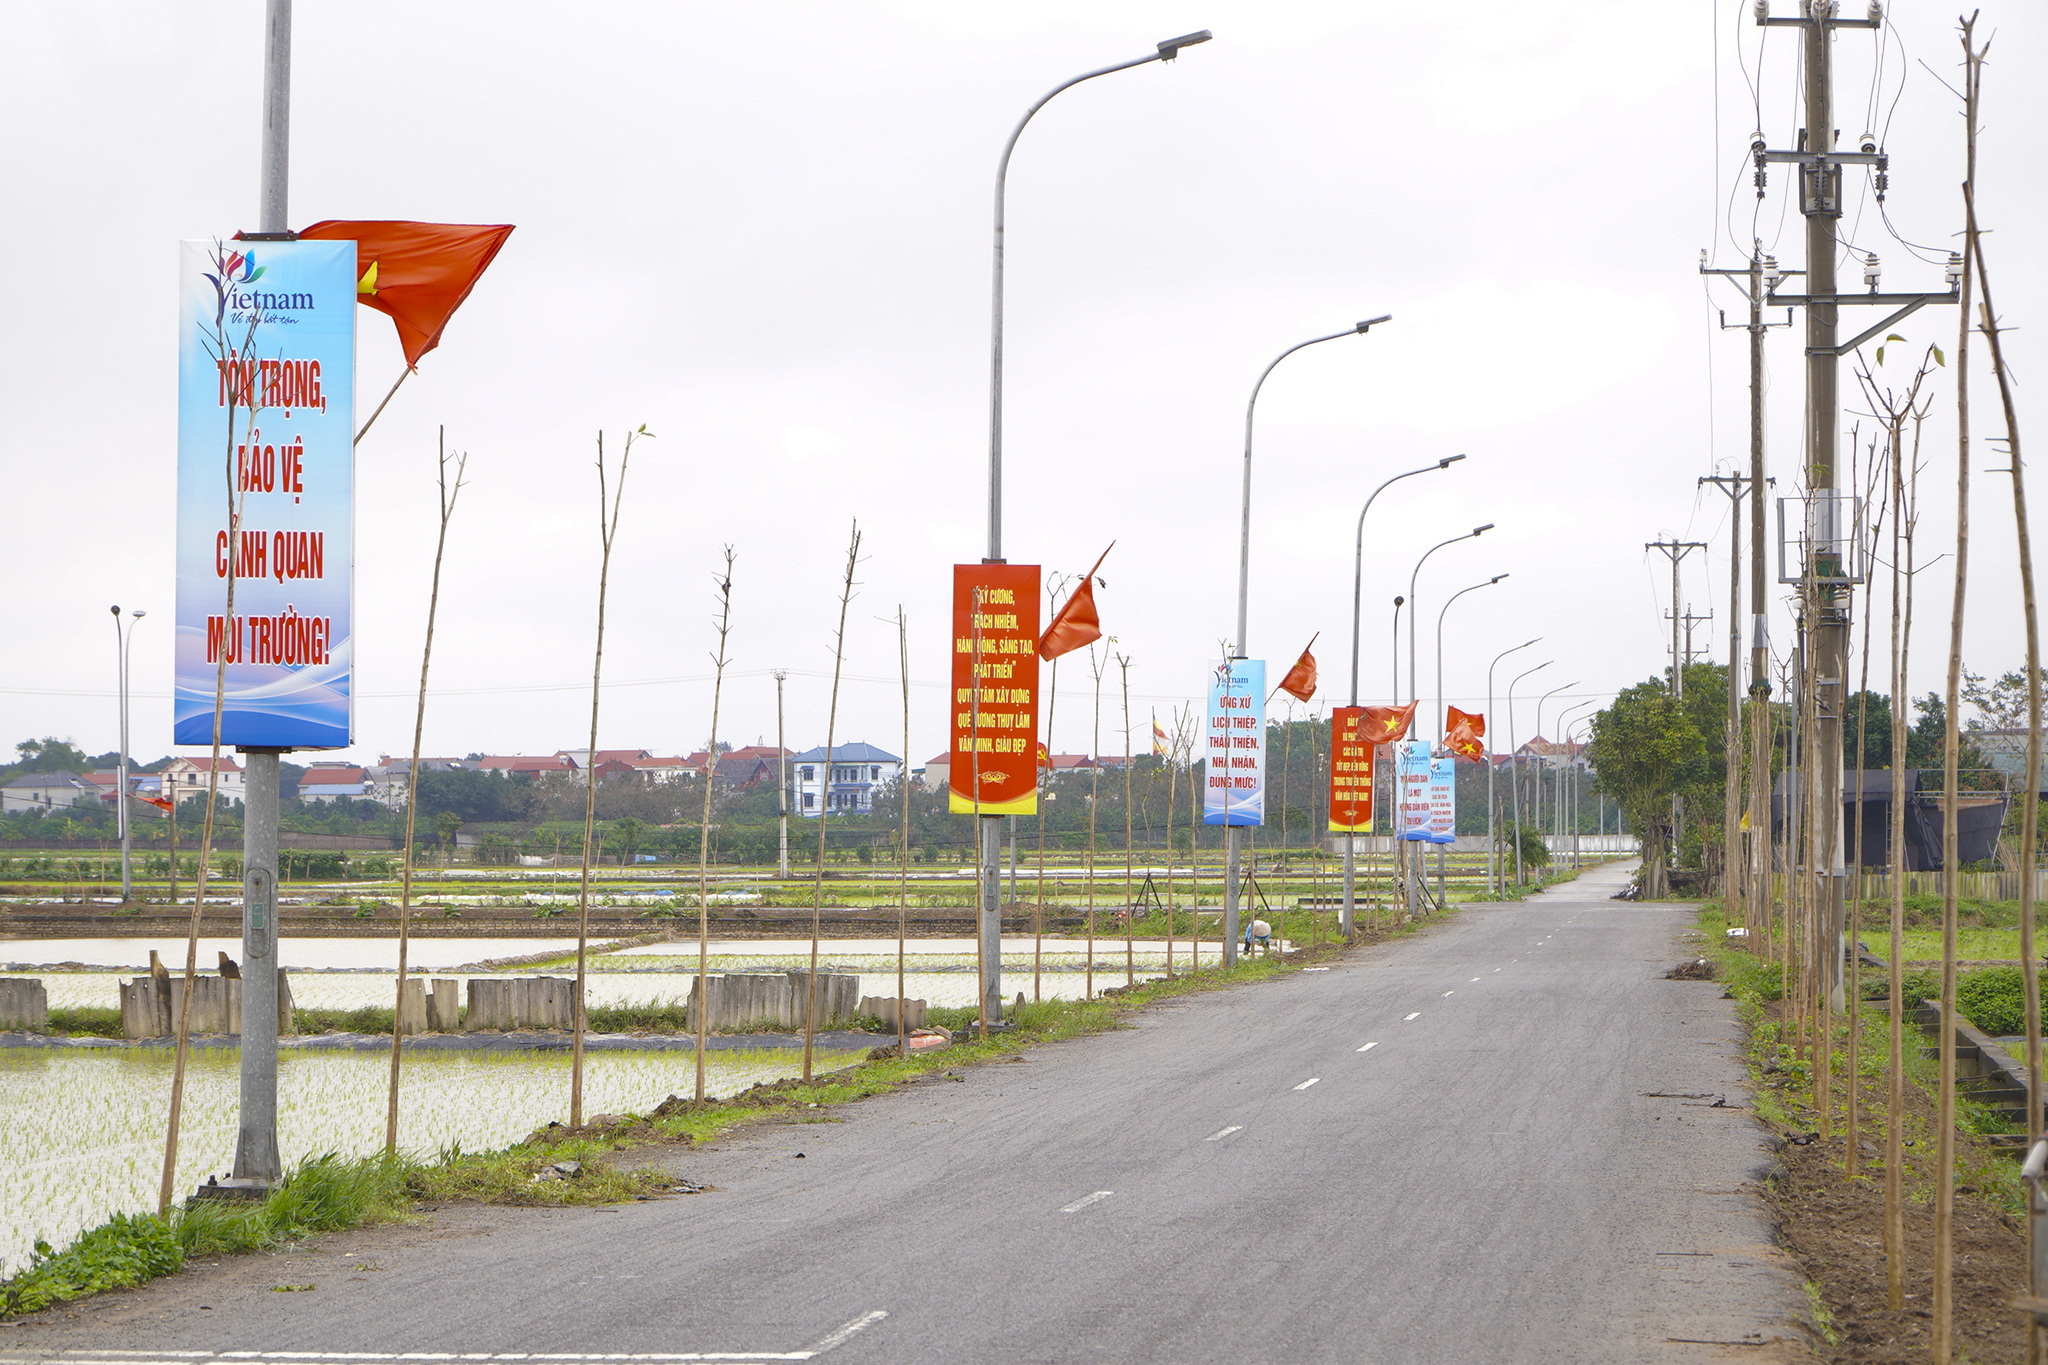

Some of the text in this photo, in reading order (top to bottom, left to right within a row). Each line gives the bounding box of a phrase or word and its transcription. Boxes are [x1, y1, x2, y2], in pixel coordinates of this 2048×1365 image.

[201, 272, 315, 328] Vietnam
[261, 358, 326, 419] TRỌNG,
[238, 428, 304, 505] BẢO VỆ
[273, 530, 324, 584] QUAN
[990, 588, 1016, 606] CƯƠNG,
[994, 611, 1019, 632] NHIỆM,
[249, 604, 331, 666] TRƯỜNG!
[999, 636, 1018, 654] SÁNG
[1019, 639, 1035, 657] TẠO,
[1213, 670, 1249, 689] Vienam
[980, 685, 994, 704] TÂM
[996, 686, 1009, 705] XÂY
[1010, 687, 1030, 707] DỰNG
[974, 711, 996, 729] ƯƠNG
[1015, 711, 1030, 729] LÂM
[1233, 715, 1257, 732] THIỆP,
[995, 735, 1012, 753] GIÀU
[1012, 738, 1027, 756] ĐẸP
[1233, 735, 1259, 752] THIỆN,
